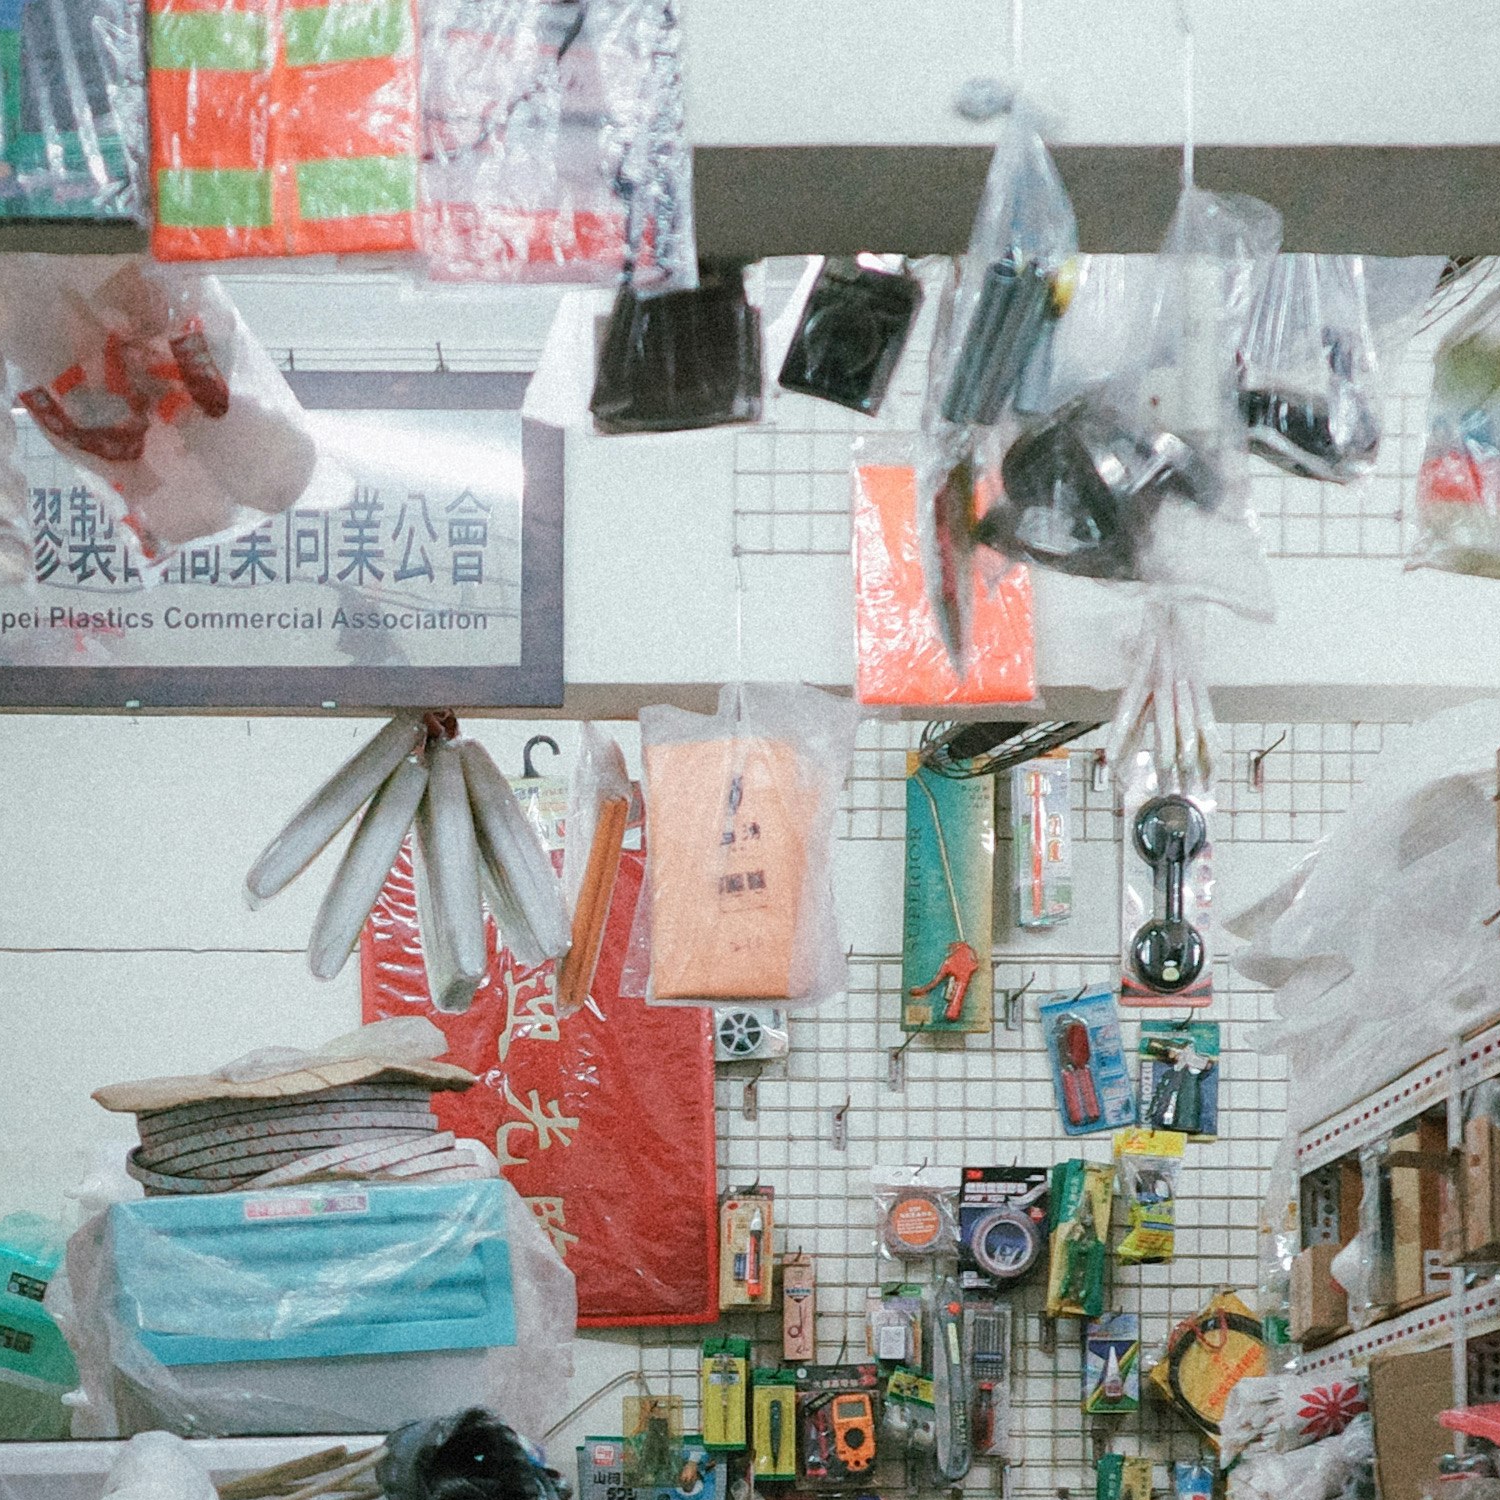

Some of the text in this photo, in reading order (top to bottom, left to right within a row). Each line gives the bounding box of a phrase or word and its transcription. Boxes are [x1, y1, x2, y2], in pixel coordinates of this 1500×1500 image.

[29, 484, 492, 586] 膠製業同業公會
[49, 606, 154, 631] Plastics
[164, 606, 323, 631] Commercial
[331, 606, 488, 631] Association
